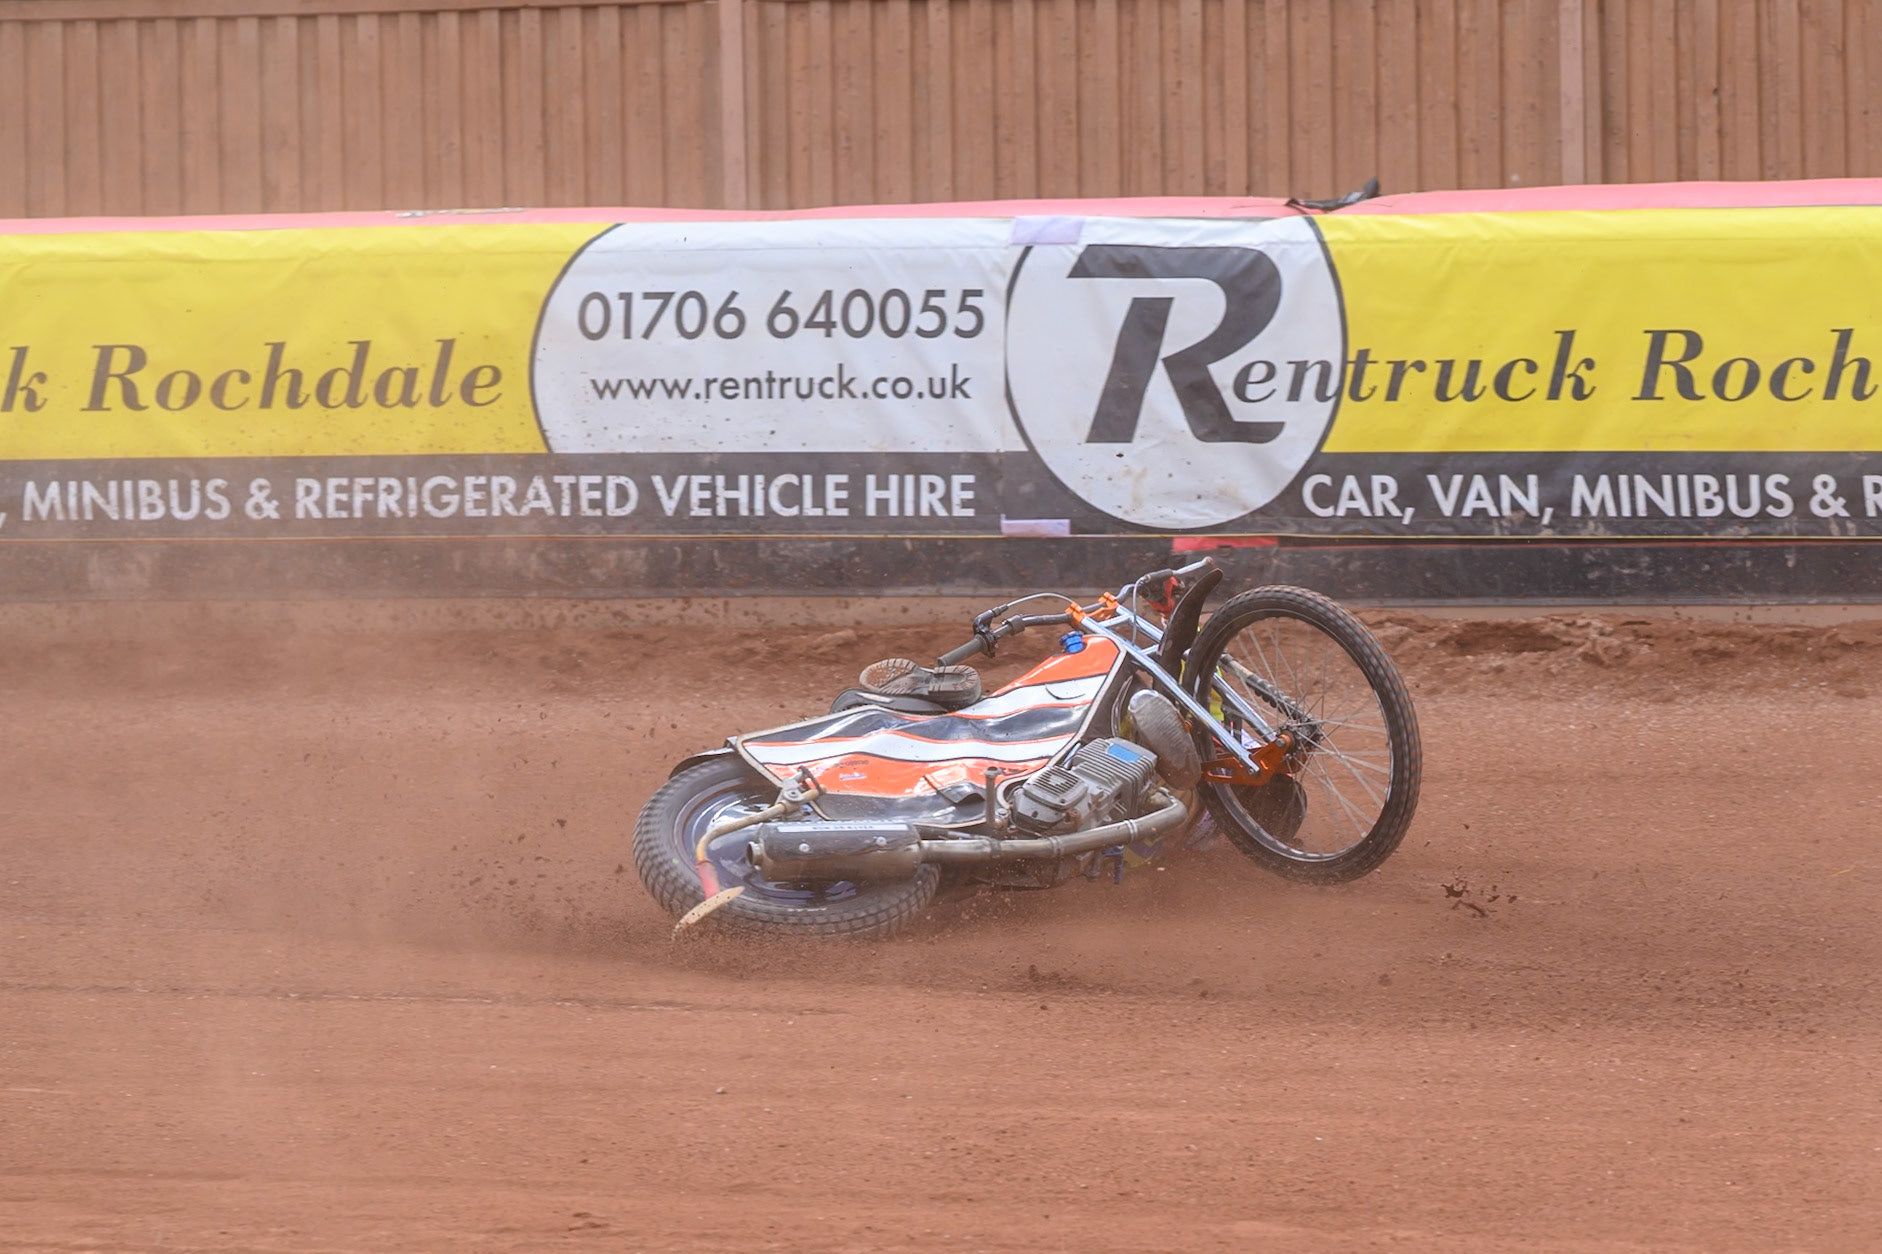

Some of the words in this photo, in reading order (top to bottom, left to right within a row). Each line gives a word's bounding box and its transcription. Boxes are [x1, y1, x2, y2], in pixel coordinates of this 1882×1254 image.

[577, 290, 747, 341] 01706
[766, 288, 986, 339] 640055
[1066, 244, 1596, 444] Rentruck
[1631, 328, 1879, 402] Roch
[80, 338, 503, 413] Rochdale
[591, 363, 972, 401] www.rentruck.co.uk
[23, 479, 231, 521] MINIBUS
[245, 478, 280, 520] &
[295, 475, 639, 519] REFRIGERATED
[651, 474, 851, 517] VEHICLE
[865, 474, 976, 517] HIRE
[1302, 474, 1415, 525] CAR,
[1428, 474, 1552, 525] VAN,
[1570, 474, 1794, 518] MINIBUS
[1809, 473, 1851, 518] &
